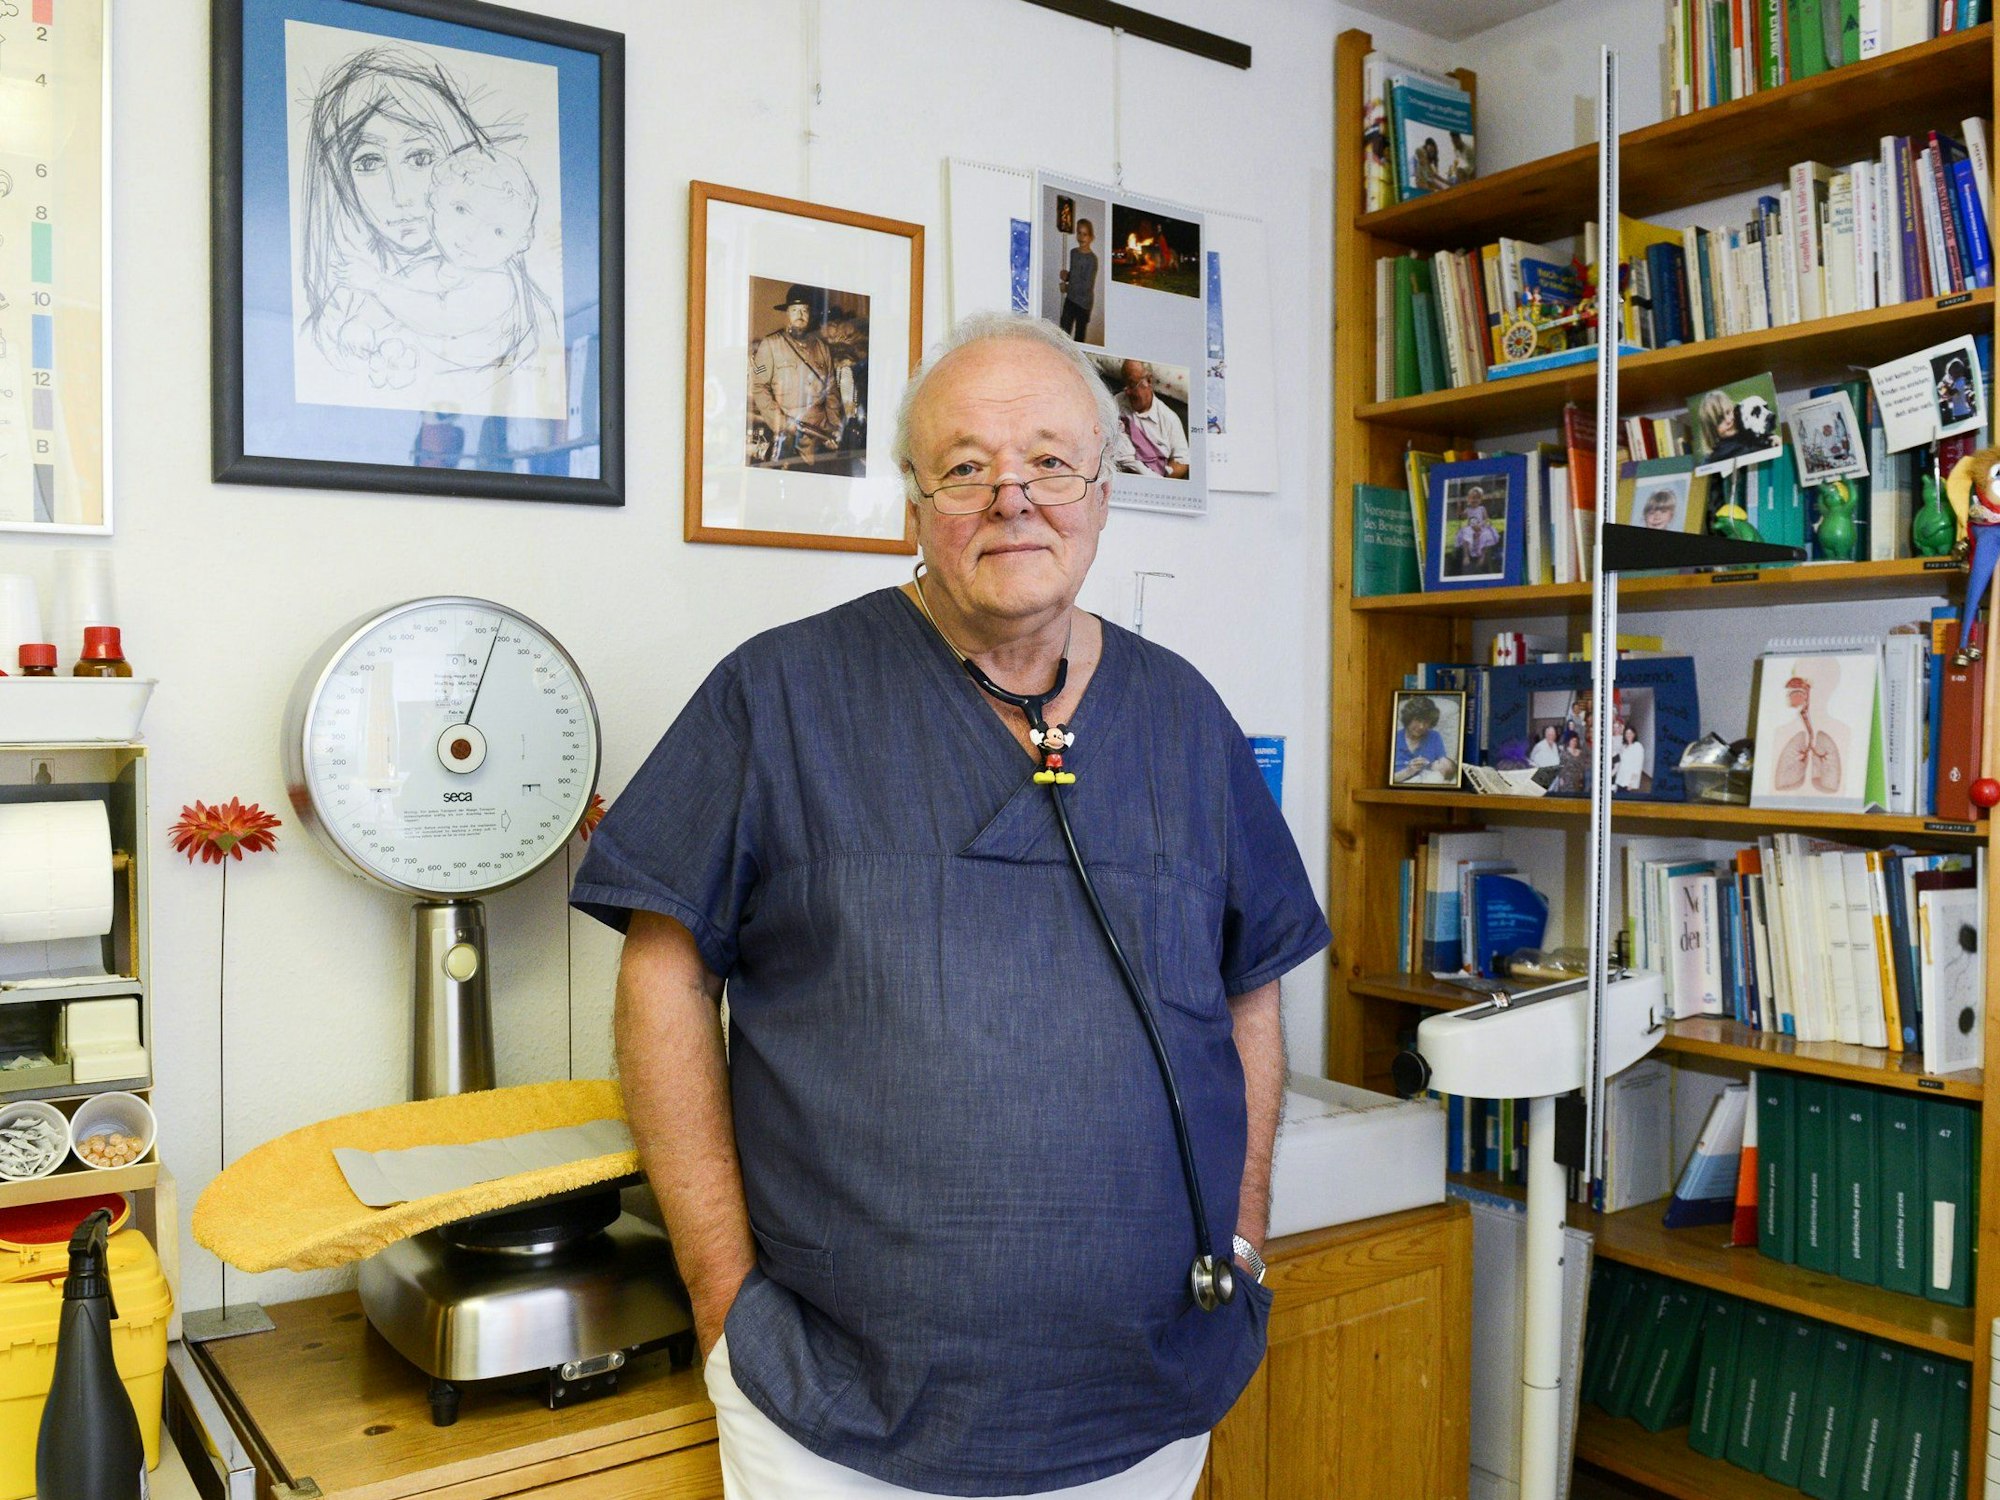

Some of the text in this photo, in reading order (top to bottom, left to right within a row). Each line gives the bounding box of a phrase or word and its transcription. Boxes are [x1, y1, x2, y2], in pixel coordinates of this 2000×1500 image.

[36, 27, 48, 42] 2
[35, 73, 48, 88] 4
[36, 164, 48, 178] 6
[36, 205, 48, 220] 8
[1938, 188, 1952, 228] SCHLAFEN
[1797, 167, 1811, 274] Gesundheit im Kindesalter
[32, 291, 50, 306] 10
[32, 372, 50, 386] 12
[36, 439, 49, 454] B
[1364, 520, 1377, 529] des
[1364, 532, 1374, 543] im
[443, 792, 472, 802] seca
[1680, 922, 1700, 952] der
[1809, 1105, 1820, 1114] 44
[1850, 1113, 1862, 1122] 45
[1894, 1121, 1906, 1130] 46
[1939, 1129, 1952, 1138] 47
[1797, 1328, 1808, 1336] 37
[1923, 1366, 1934, 1374] 41
[1819, 1431, 1831, 1478] pädiatrische
[1862, 1418, 1879, 1491] pädiatrische praxis
[1905, 1432, 1922, 1500] ädiatrische praxis
